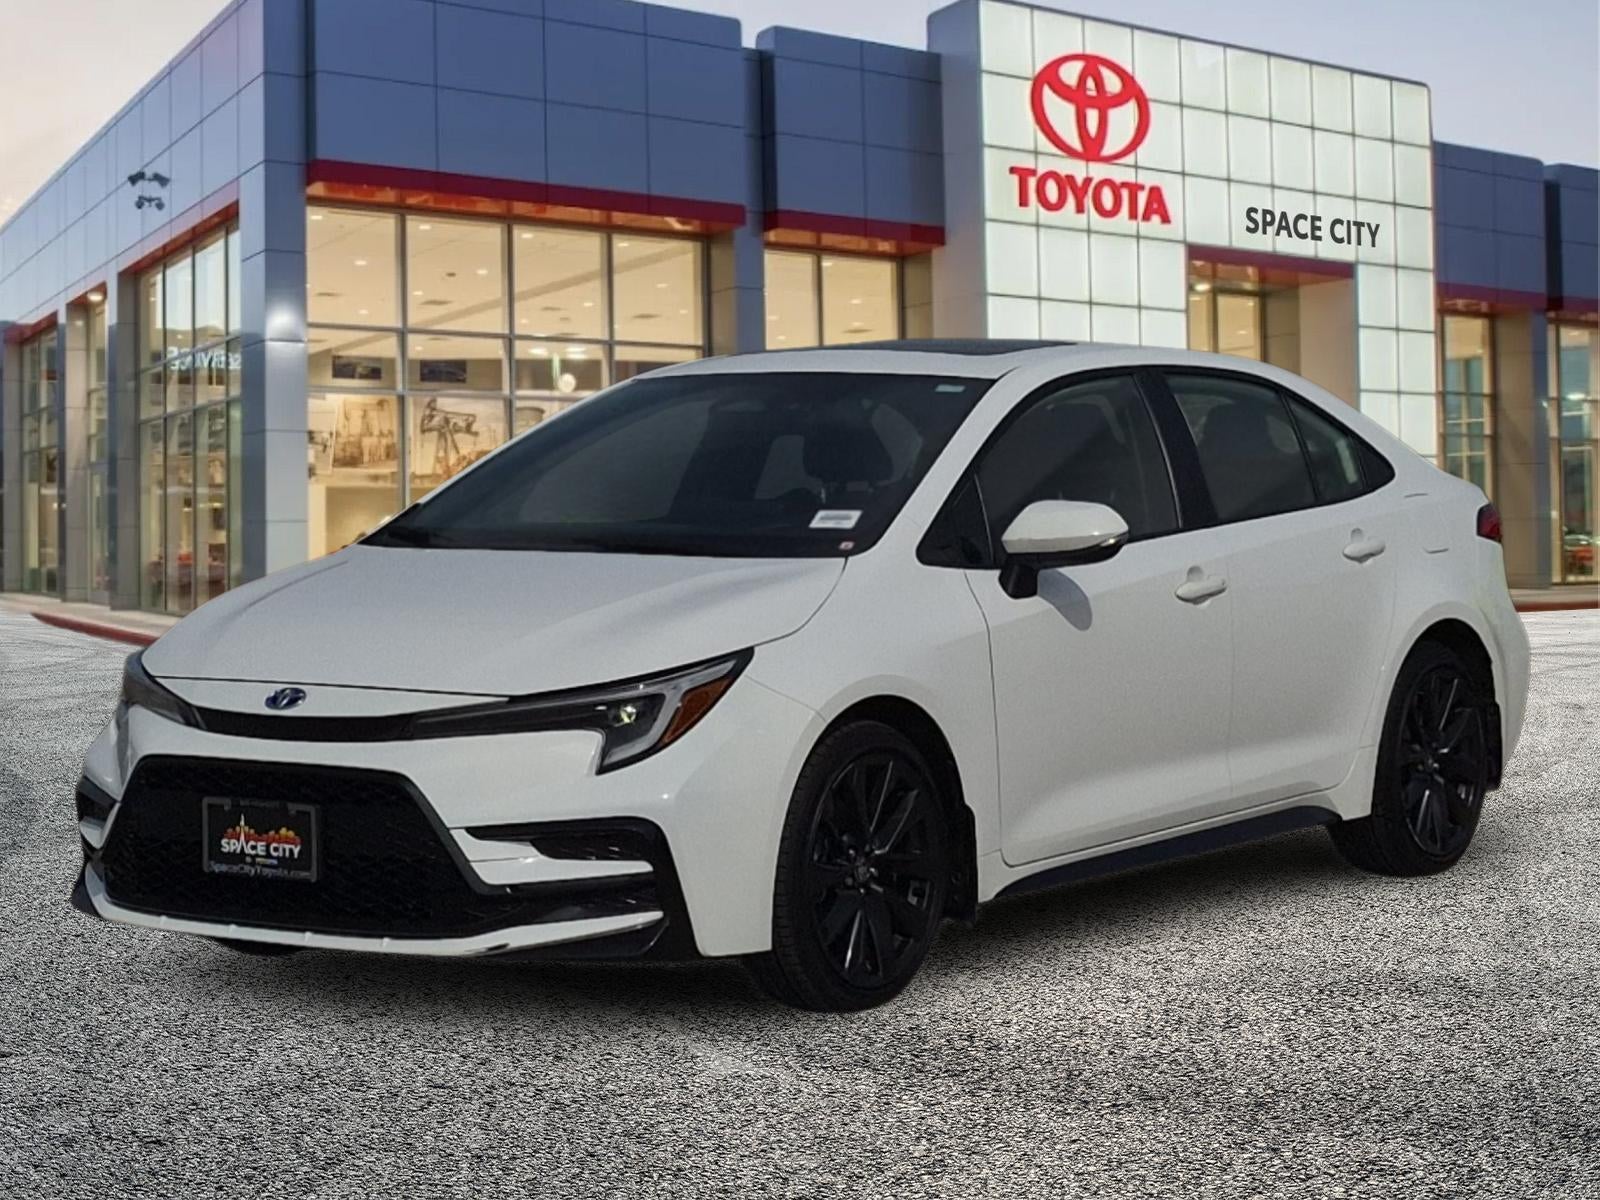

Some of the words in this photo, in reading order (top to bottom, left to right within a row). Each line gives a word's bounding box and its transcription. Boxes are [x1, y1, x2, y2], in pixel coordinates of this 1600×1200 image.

[1009, 166, 1171, 224] TOYOTA
[1245, 207, 1322, 241] SPACE
[1330, 217, 1381, 248] CITY
[221, 839, 267, 856] SPACE
[270, 843, 301, 859] CITY
